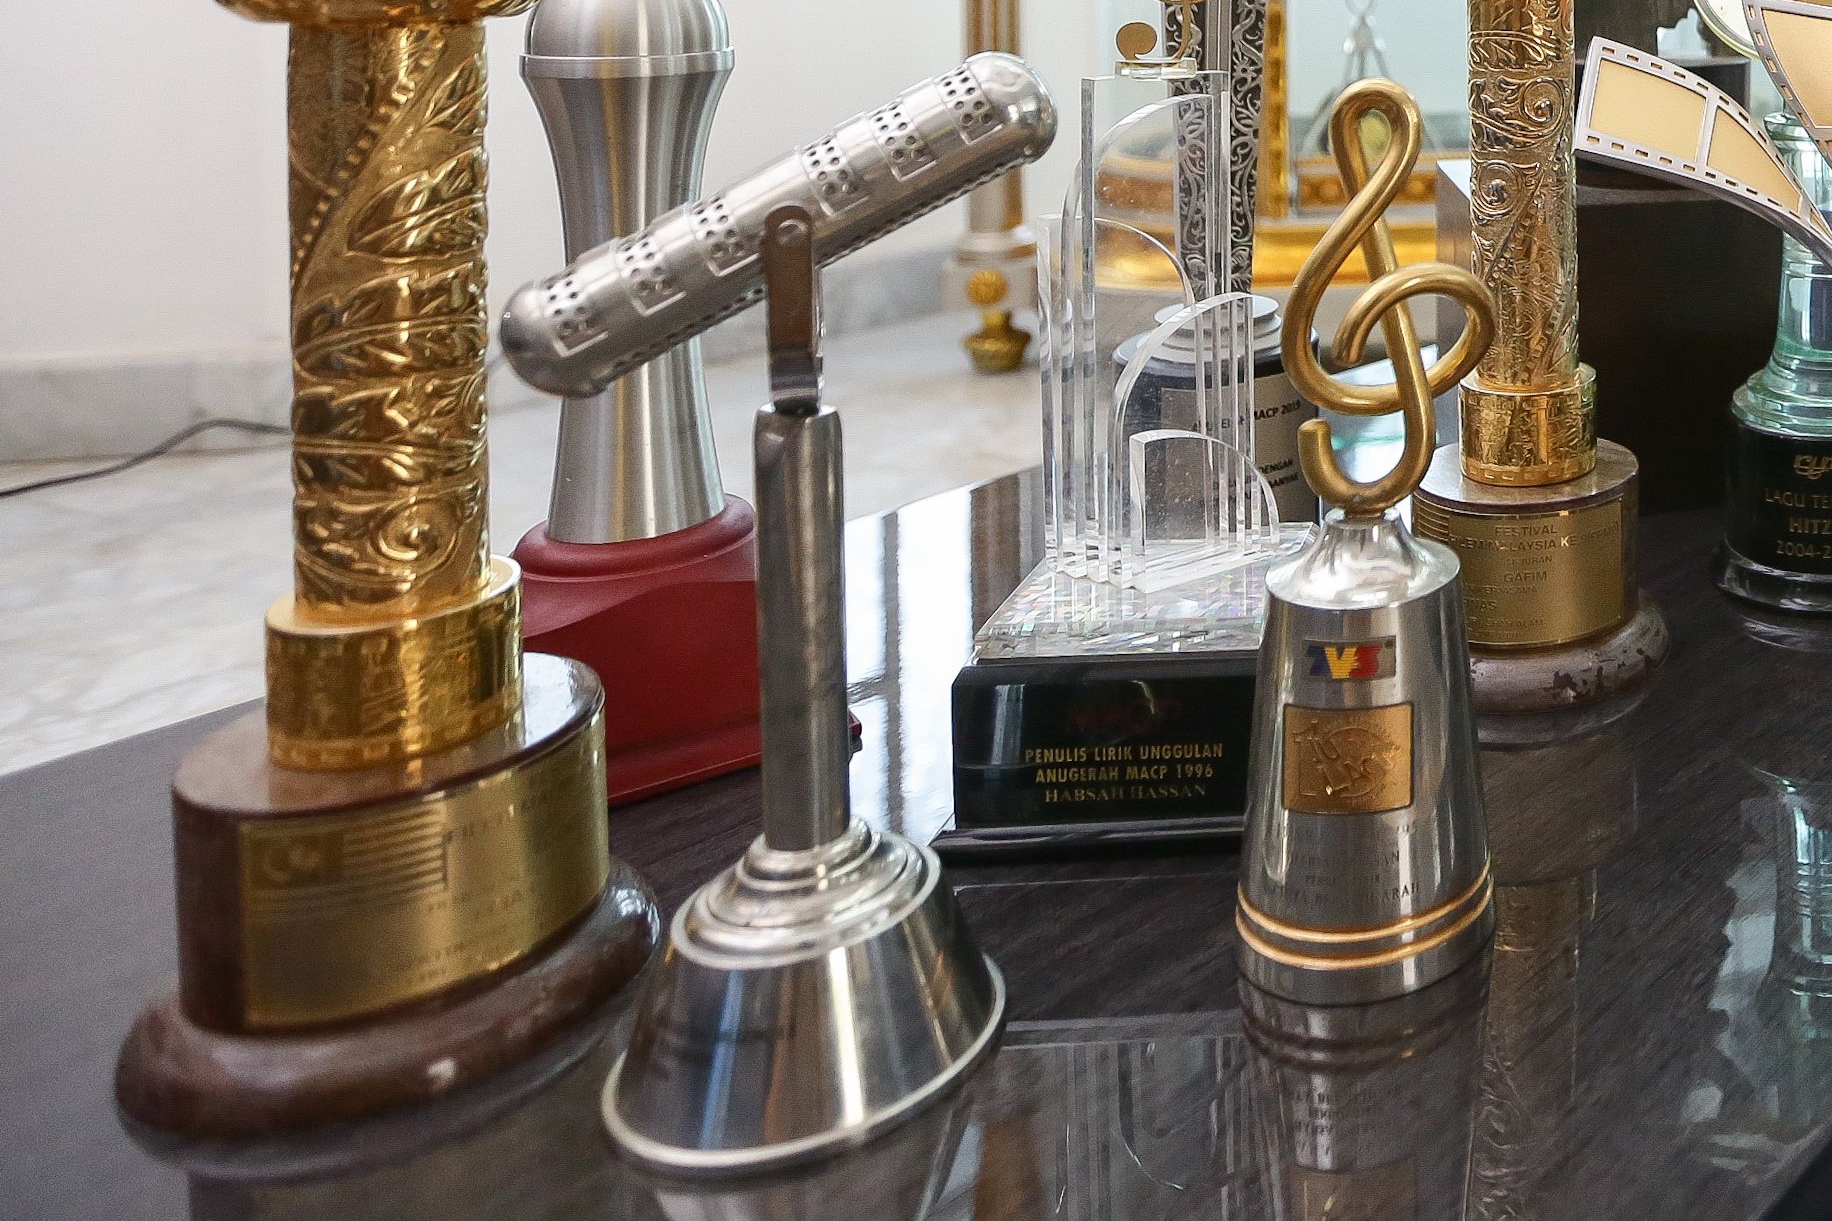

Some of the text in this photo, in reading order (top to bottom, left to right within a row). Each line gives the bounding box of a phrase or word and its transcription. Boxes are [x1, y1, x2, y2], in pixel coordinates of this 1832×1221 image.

[1765, 487, 1806, 508] LAGU
[1494, 523, 1558, 537] FESTIVAL
[1788, 517, 1832, 535] HITZ
[1024, 743, 1224, 763] PENULIS LIRIK UNGGULAN
[1035, 763, 1214, 783] ANUGERAH MACP 1996
[1046, 783, 1207, 803] HABSAH HASSAN
